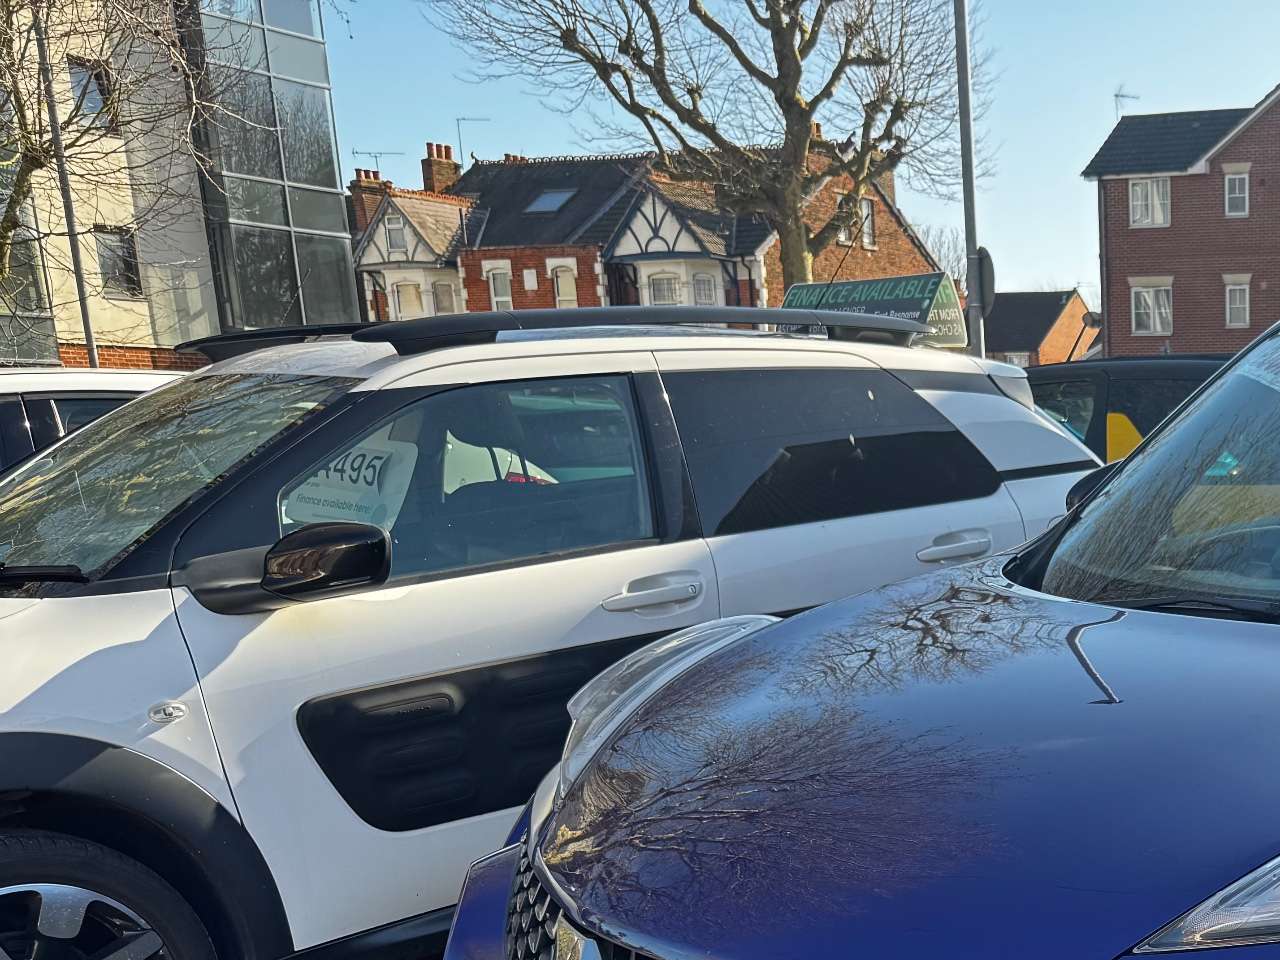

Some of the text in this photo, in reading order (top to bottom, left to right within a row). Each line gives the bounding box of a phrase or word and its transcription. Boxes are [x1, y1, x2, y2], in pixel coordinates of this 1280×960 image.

[784, 278, 938, 307] FINANCE AVAILABLE
[325, 452, 384, 487] 495
